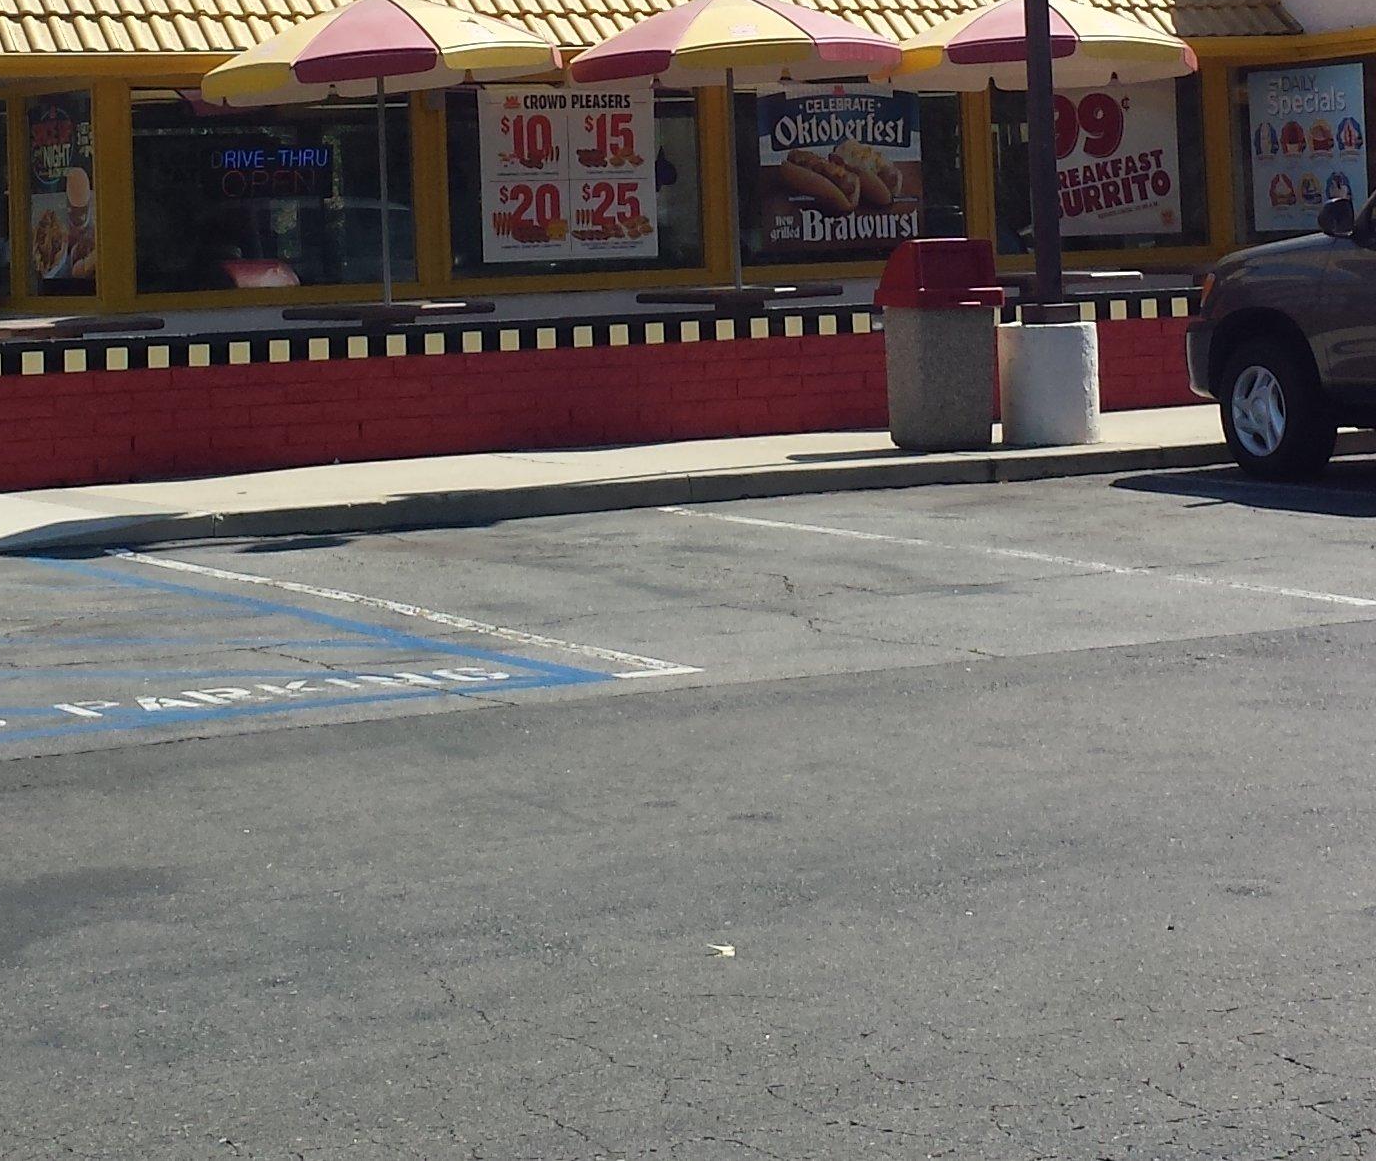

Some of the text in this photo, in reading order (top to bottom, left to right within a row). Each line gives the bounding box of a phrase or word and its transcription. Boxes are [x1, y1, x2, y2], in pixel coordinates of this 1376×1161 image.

[1280, 75, 1317, 91] DAILY
[524, 94, 631, 110] CROWD PLEASERS
[805, 97, 876, 114] CELEBRATE
[1266, 86, 1347, 119] Specials
[501, 113, 635, 158] $10 $15
[775, 113, 904, 146] Oktoberfest
[44, 143, 71, 169] NIGHT
[211, 148, 328, 169] DRIVE-THRU
[1057, 149, 1163, 190] REAKFAST
[222, 170, 316, 197] OPEN
[1059, 169, 1171, 219] URRITO
[499, 182, 641, 228] $20 $25
[775, 214, 794, 226] new
[770, 208, 919, 242] grilled Bratwurst
[54, 665, 512, 719] PARKING
